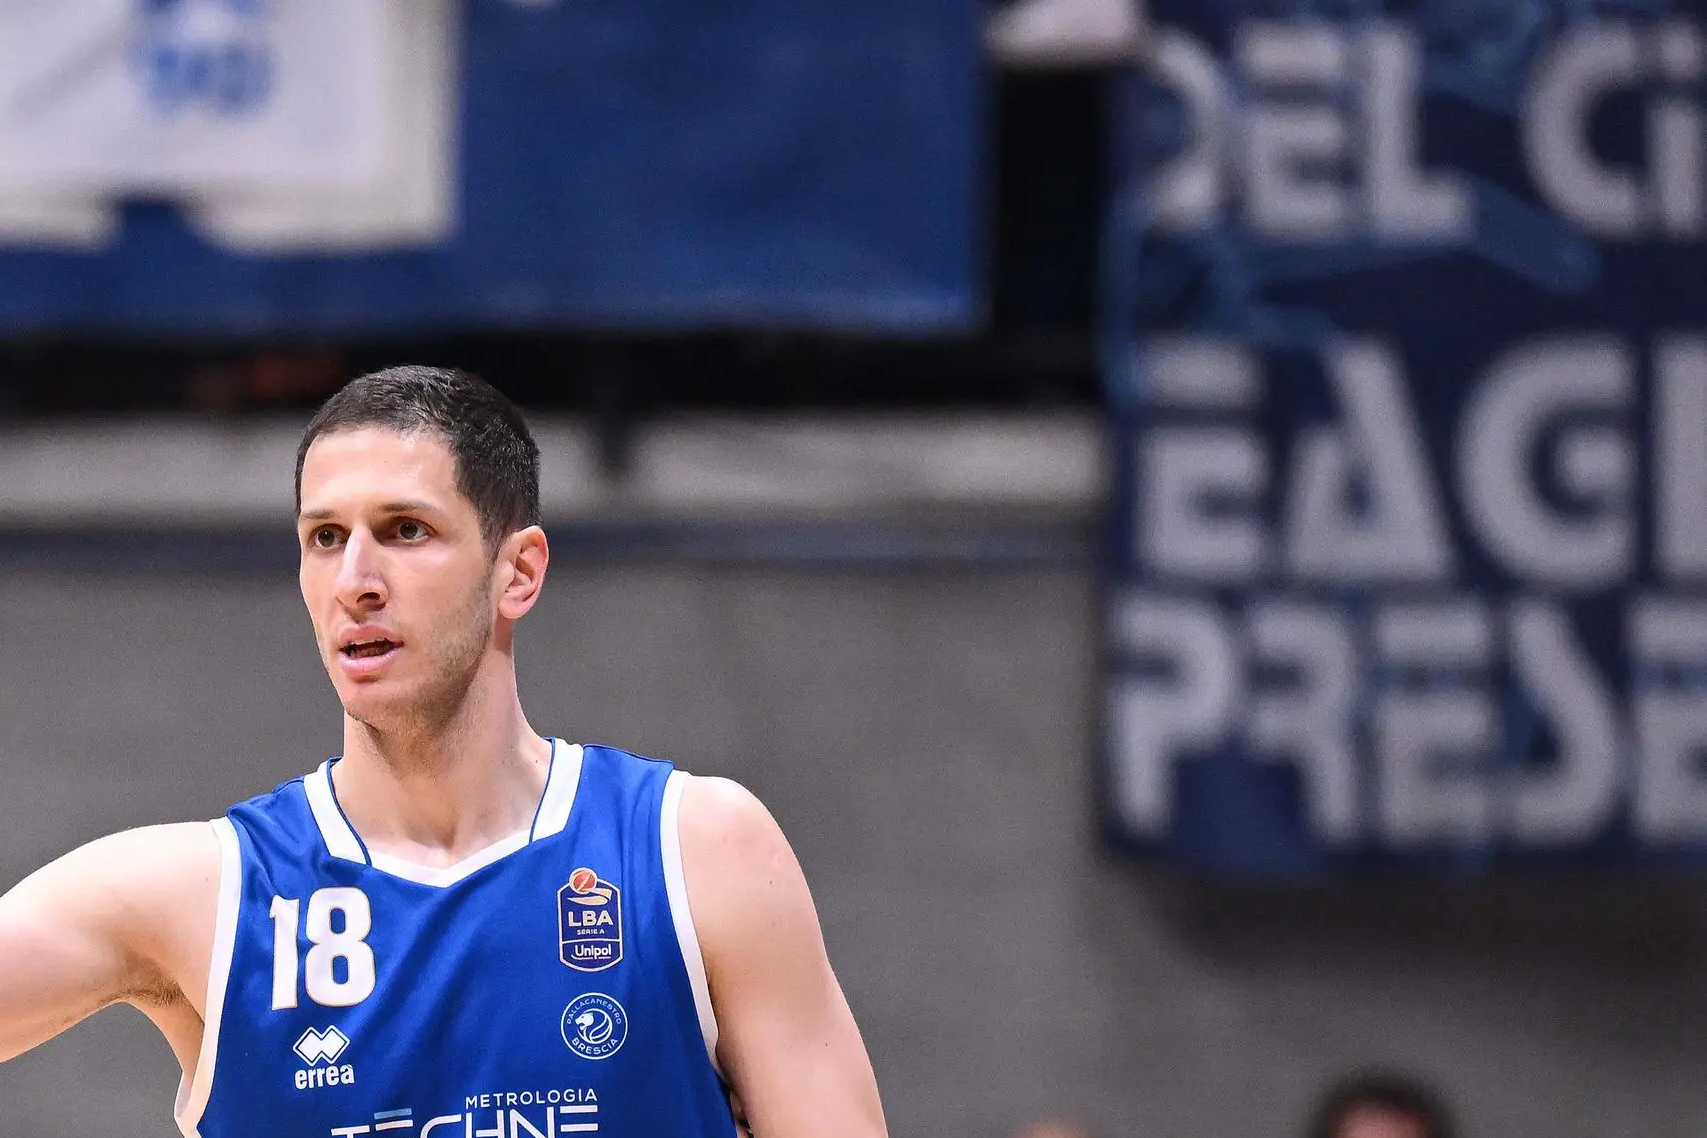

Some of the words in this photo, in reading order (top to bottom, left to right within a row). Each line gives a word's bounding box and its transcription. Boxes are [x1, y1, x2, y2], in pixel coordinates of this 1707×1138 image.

[568, 910, 614, 927] LBA
[576, 928, 598, 936] SERIE
[269, 886, 377, 1011] 18
[574, 943, 612, 960] Unipol
[566, 998, 622, 1025] PALLACANESTRO
[571, 1036, 619, 1055] BRESCIA
[465, 1088, 598, 1110] METROLOGIA
